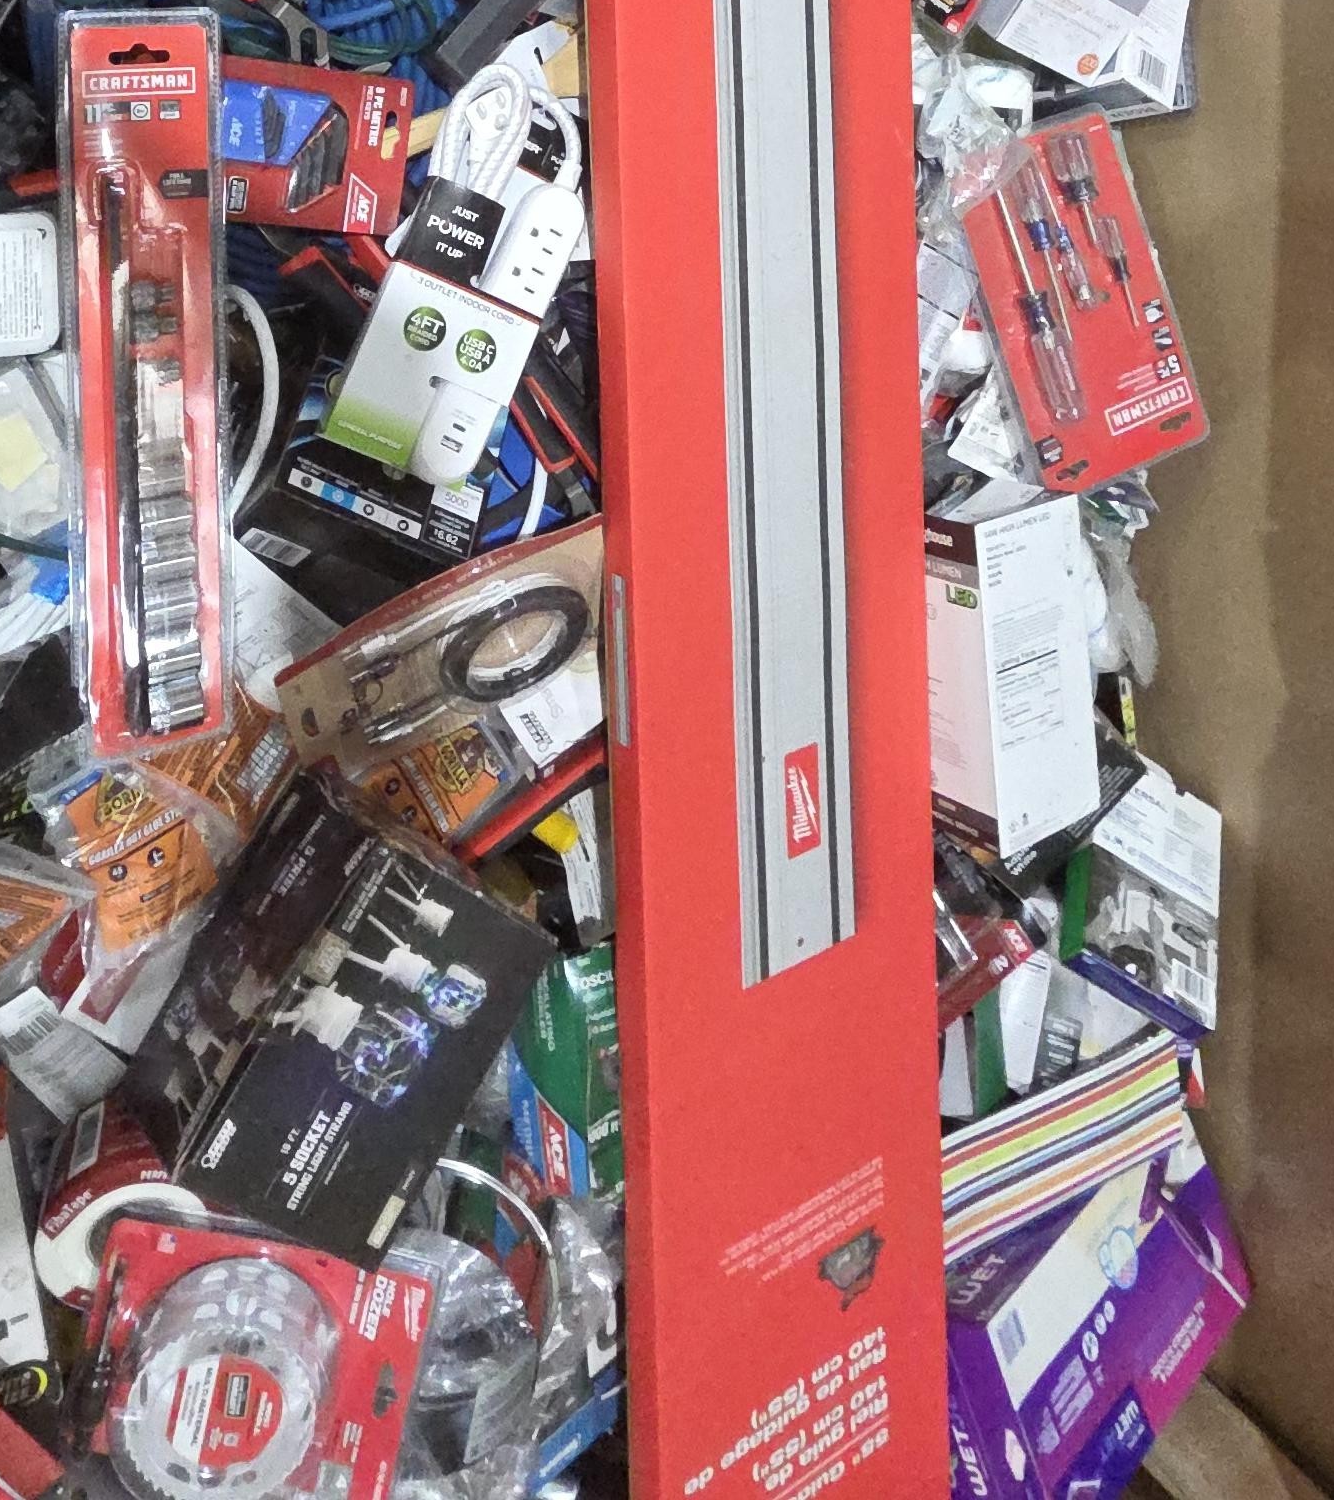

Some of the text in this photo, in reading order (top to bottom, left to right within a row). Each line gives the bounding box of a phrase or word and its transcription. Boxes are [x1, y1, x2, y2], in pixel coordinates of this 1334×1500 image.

[88, 74, 189, 90] CRAFTSMAN
[367, 109, 381, 147] METRIC
[355, 194, 371, 223] ACE
[451, 204, 479, 223] JUST
[426, 213, 486, 251] POWER
[434, 240, 464, 260] IT UP
[423, 279, 459, 300] OUTLET
[458, 294, 490, 315] INDOOR
[490, 310, 515, 325] CORD
[408, 312, 444, 335] 4FT
[458, 344, 491, 365] USB A
[458, 354, 483, 371] 4.0A
[462, 334, 495, 354] USB C
[1111, 384, 1185, 427] CRAFTSMAN
[443, 491, 470, 508] 5000
[944, 584, 979, 609] LED
[785, 764, 813, 842] Milwaukee
[280, 1108, 332, 1187] 5 SOCKET
[285, 1099, 353, 1211] STRING LIGHT STRAND
[548, 1124, 565, 1178] ACE
[362, 1274, 388, 1341] DOZER
[381, 1279, 397, 1317] HOLE
[746, 1324, 886, 1429] 140 cm (55")
[681, 1343, 890, 1495] Rail de guidage de
[748, 1373, 888, 1483] 140 cm (55")
[847, 1392, 891, 1432] Riel
[761, 1460, 795, 1492] de
[951, 1424, 987, 1494] WET
